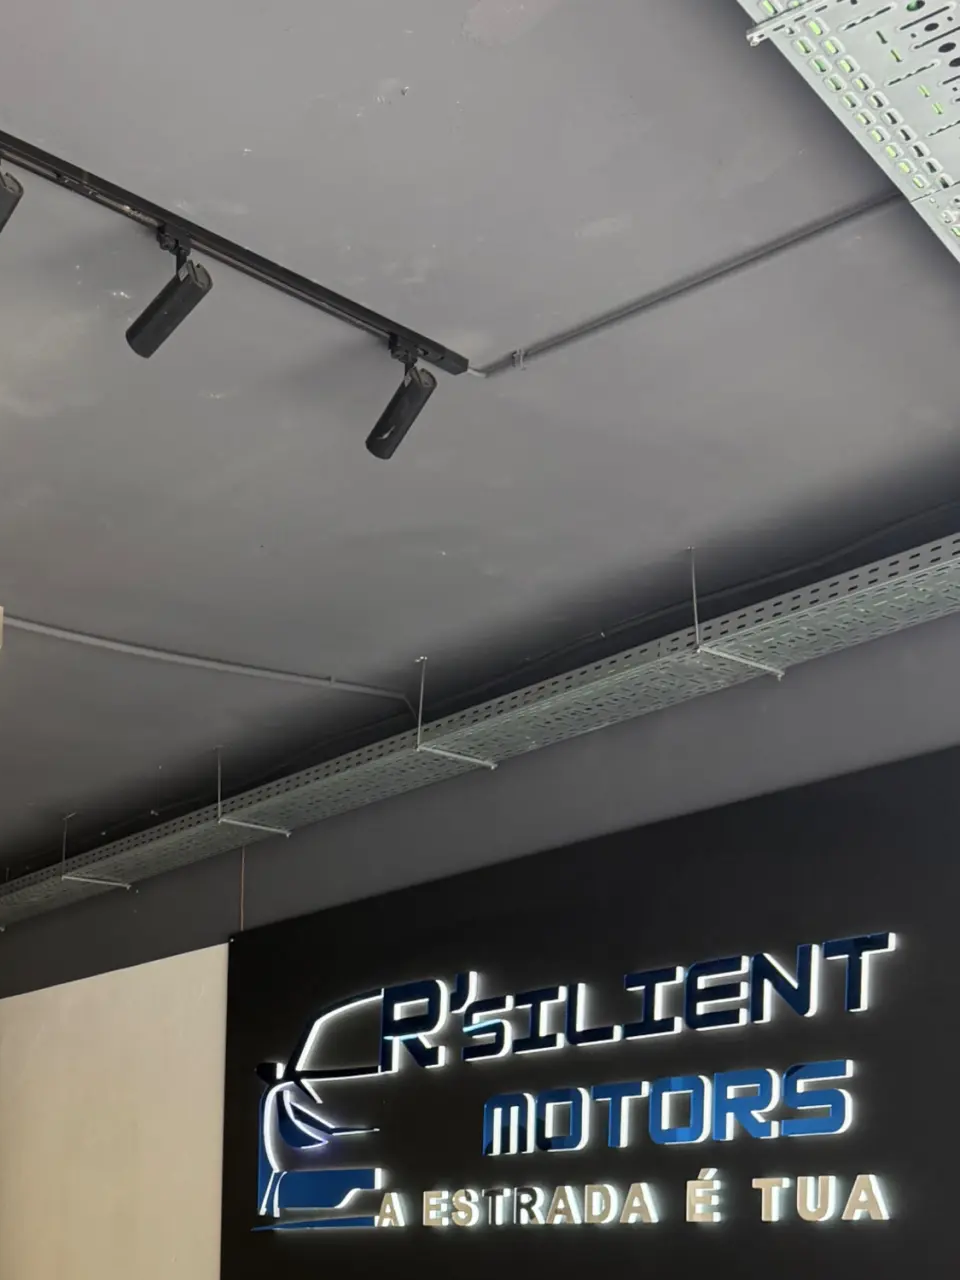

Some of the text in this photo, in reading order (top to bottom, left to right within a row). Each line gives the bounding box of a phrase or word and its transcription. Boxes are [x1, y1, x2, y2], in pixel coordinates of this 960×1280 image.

[380, 932, 897, 1073] R'SILIENT
[483, 1059, 854, 1156] MOTORS
[379, 1168, 891, 1227] A ESTRADA É TUA
